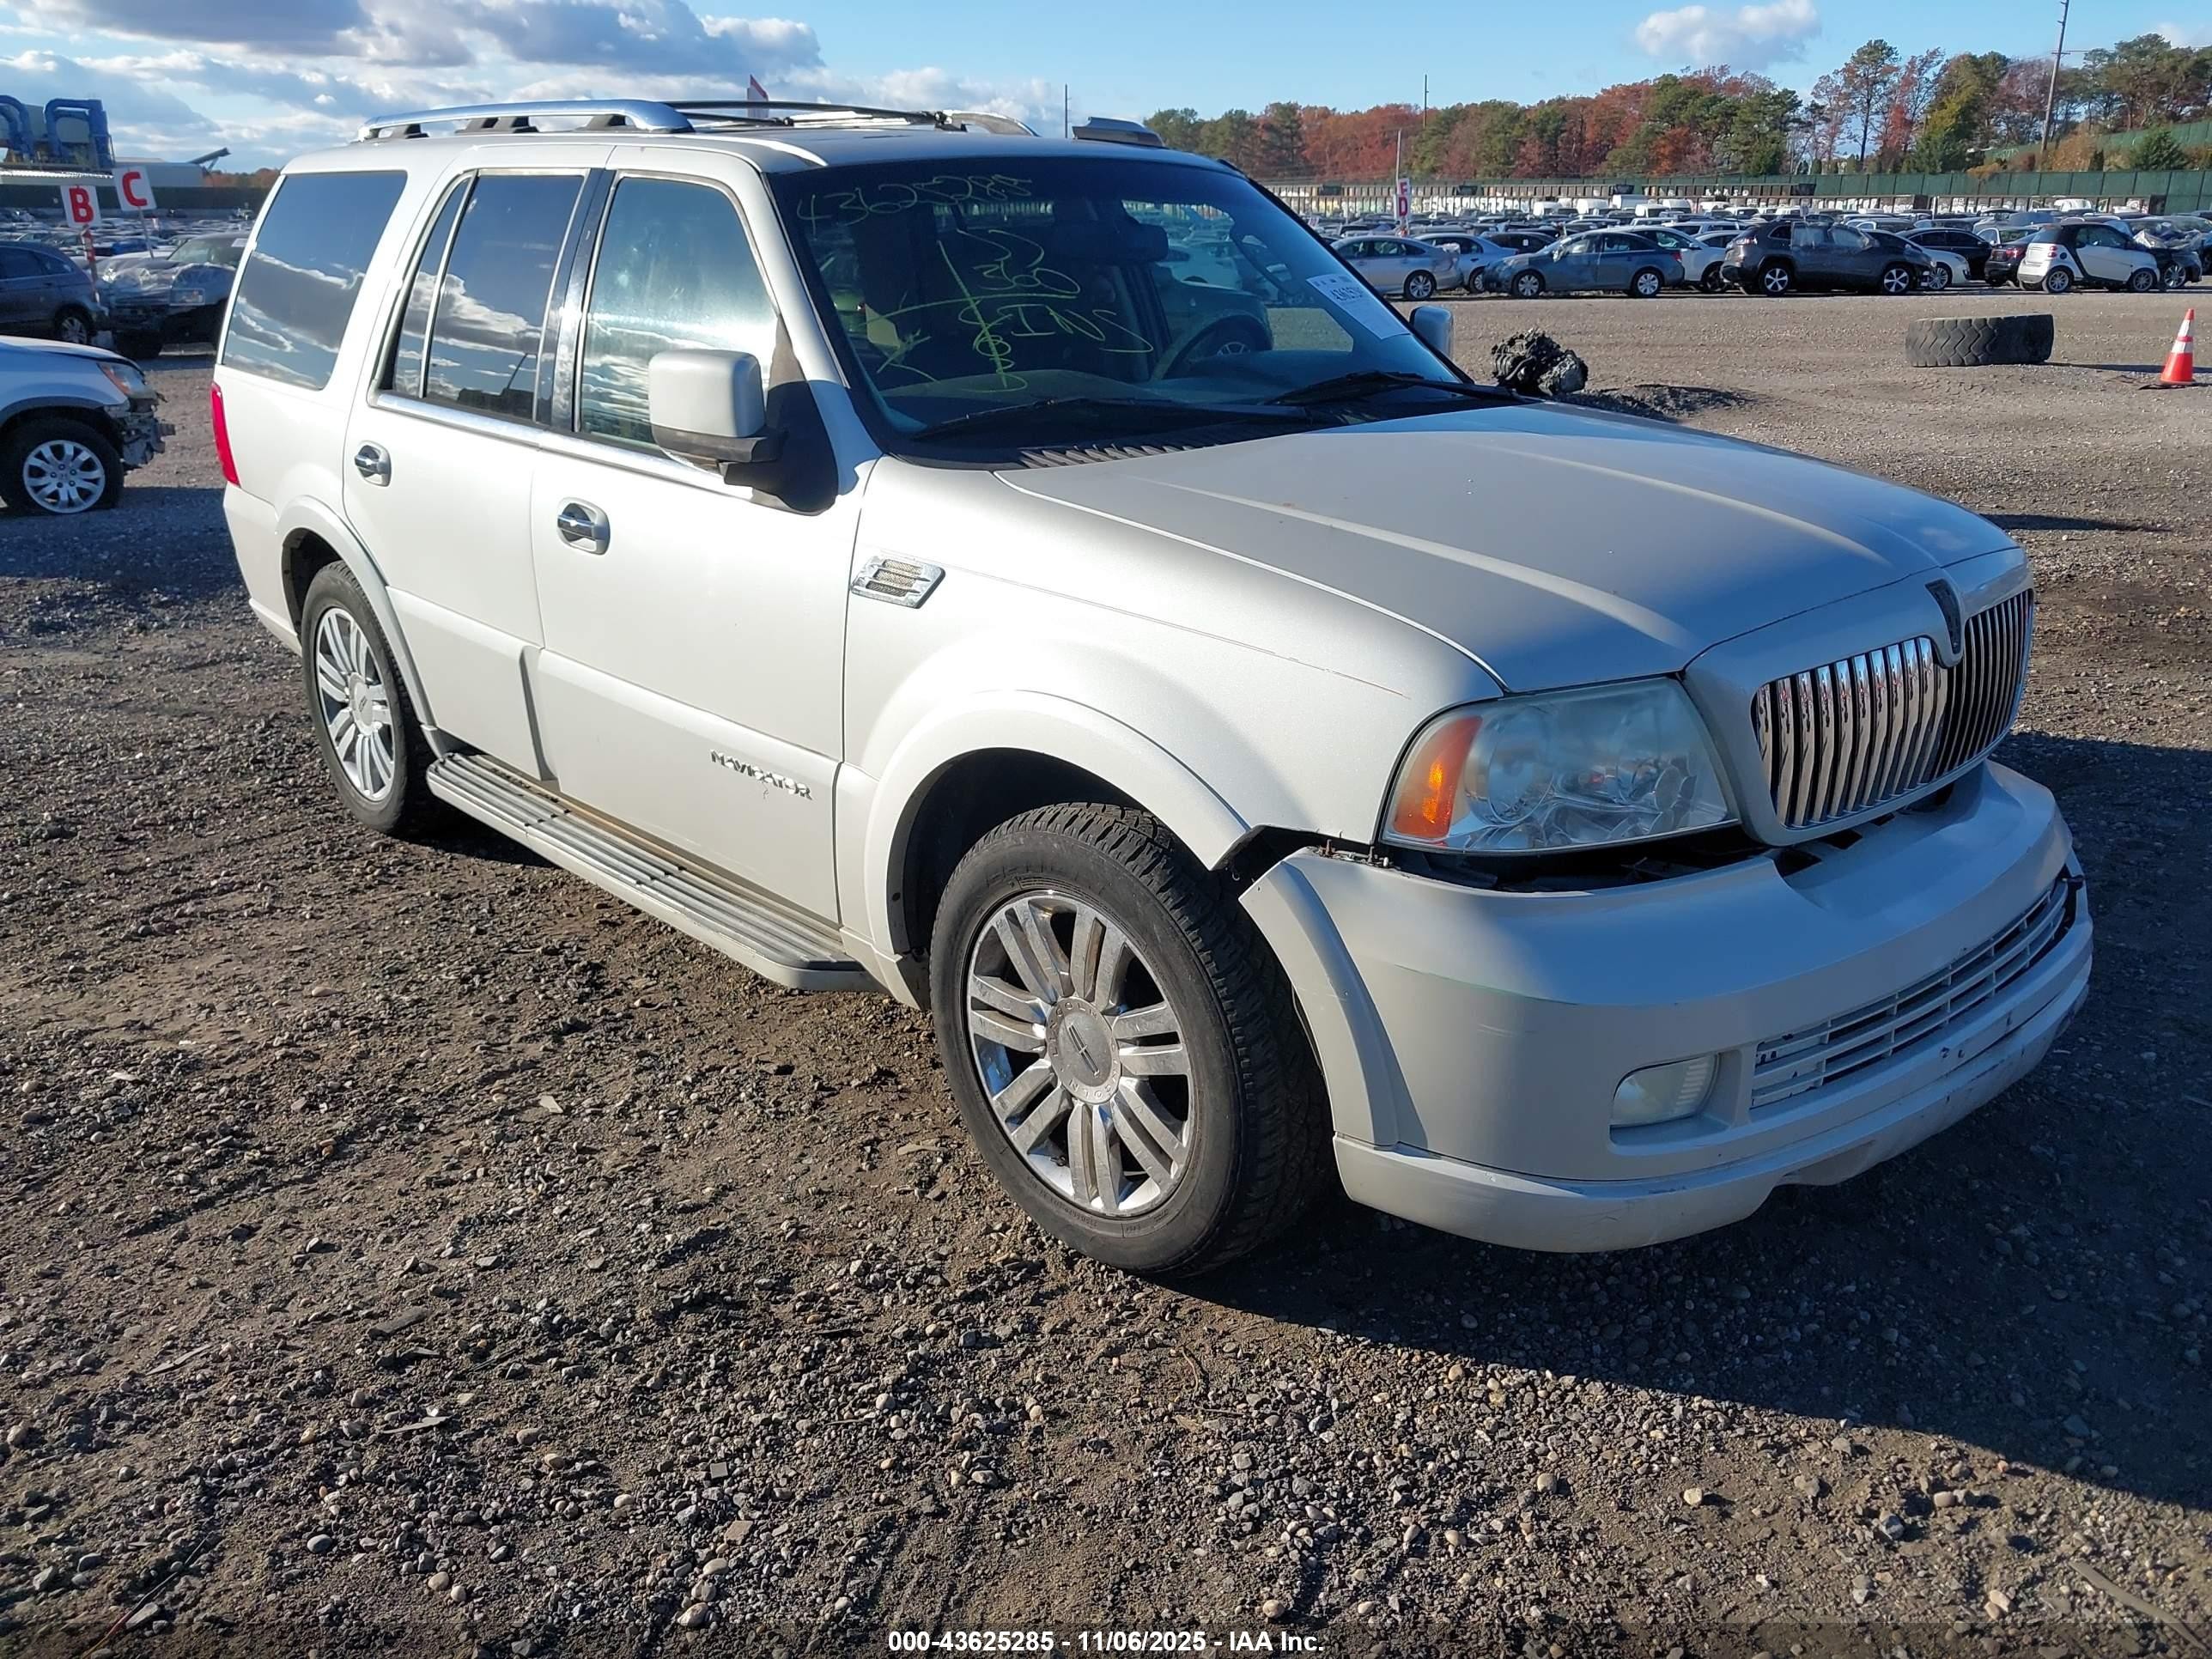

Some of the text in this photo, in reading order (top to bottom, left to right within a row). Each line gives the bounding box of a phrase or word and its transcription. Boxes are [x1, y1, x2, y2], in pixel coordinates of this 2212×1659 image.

[69, 186, 94, 223] B
[122, 171, 148, 207] C
[1399, 197, 1408, 216] D
